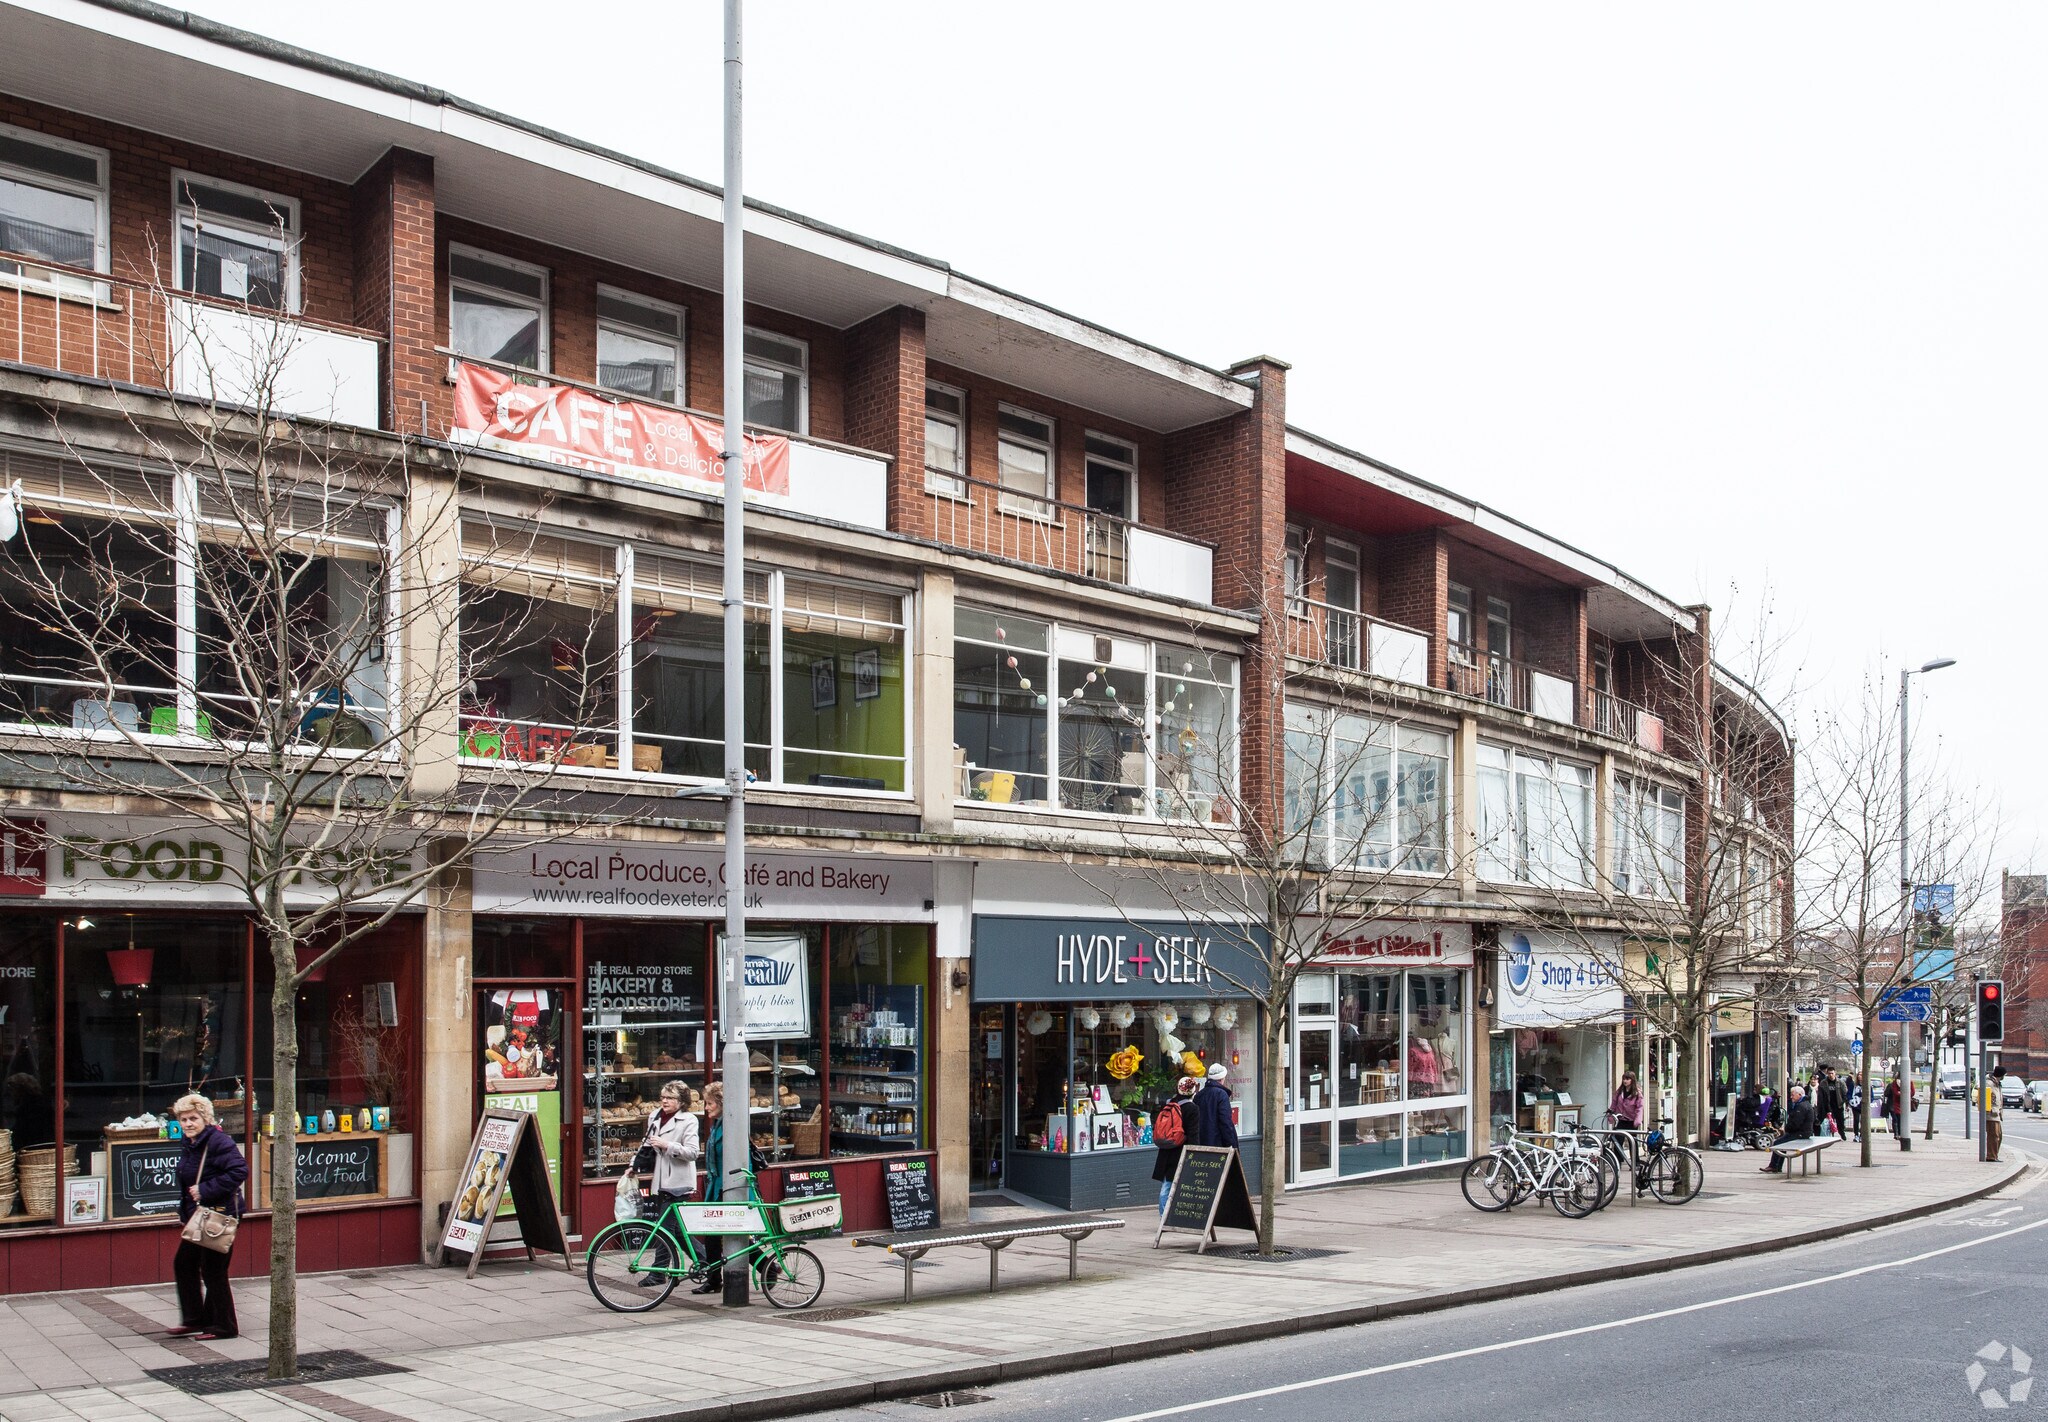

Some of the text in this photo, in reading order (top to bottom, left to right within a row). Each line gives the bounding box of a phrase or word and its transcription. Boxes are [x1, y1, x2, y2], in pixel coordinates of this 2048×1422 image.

[497, 391, 633, 459] CAFE
[644, 415, 766, 458] Local, Etcal
[644, 443, 752, 482] & Delicios!
[467, 721, 577, 765] CAFE
[63, 836, 223, 882] FOOD
[532, 853, 599, 880] Local
[609, 856, 712, 888] Produce,
[776, 866, 814, 888] and
[821, 866, 890, 895] Bakery
[532, 887, 763, 909] www.realfoodexeter.cuk
[1058, 934, 1128, 984] HYDE
[1153, 935, 1211, 984] SEEK
[589, 966, 693, 975] THE REAL FOOD STORE
[1541, 961, 1572, 991] Shop
[1576, 962, 1585, 986] 4
[588, 977, 674, 994] BAKERY &
[588, 995, 691, 1013] FOODSTORE
[770, 993, 795, 1006] bliss
[487, 1096, 536, 1111] REAL
[295, 1146, 370, 1167] elcome
[889, 1161, 926, 1172] REAL FOOD
[333, 1163, 367, 1184] Food
[789, 1170, 829, 1182] REAL FOOD
[703, 1210, 723, 1218] REAL
[789, 1205, 834, 1225] REAL FOOD
